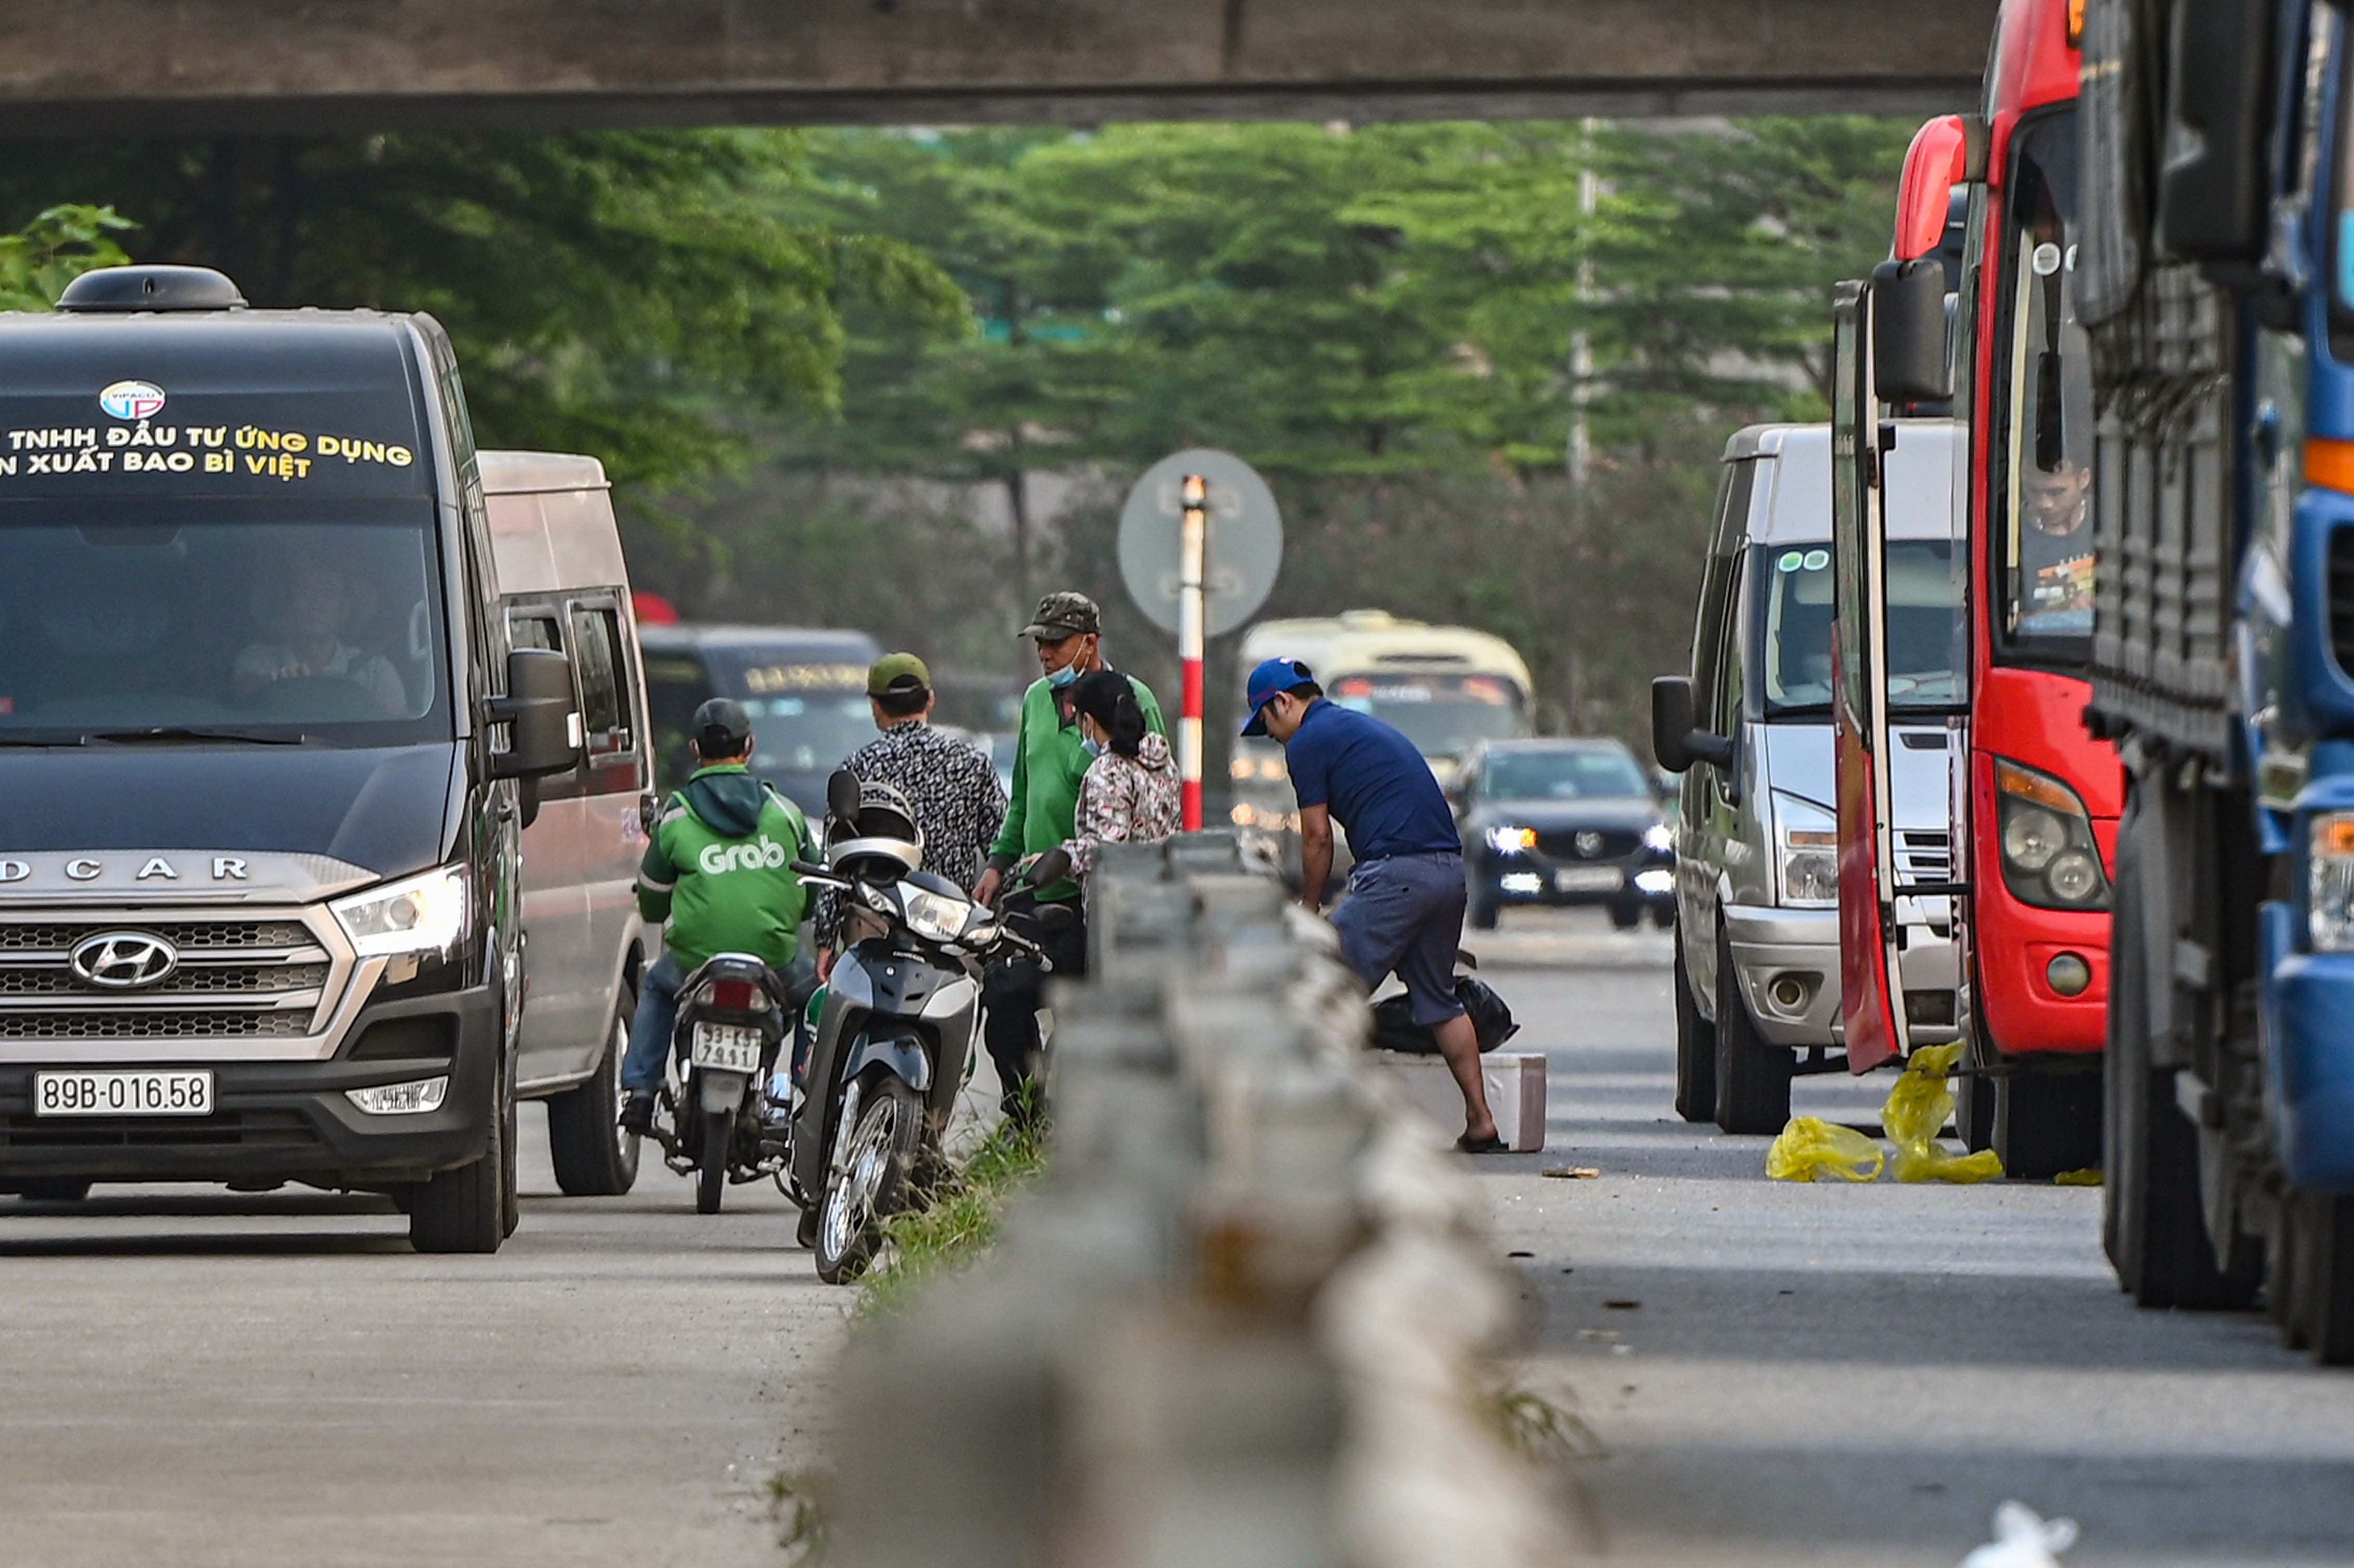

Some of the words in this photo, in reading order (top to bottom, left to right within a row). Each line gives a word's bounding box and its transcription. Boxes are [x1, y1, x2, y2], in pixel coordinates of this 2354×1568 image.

[8, 427, 96, 450] TNHH
[106, 420, 177, 447] ĐẦU
[185, 425, 227, 447] TƯ
[235, 424, 308, 452] ỨNG
[317, 435, 413, 467] DỤNG
[27, 445, 114, 475] XUẤT
[123, 451, 194, 473] BAO
[204, 448, 234, 473] BÌ
[244, 452, 311, 481] VIỆT
[699, 834, 785, 874] Grab
[44, 1077, 205, 1109] 89B-016.58
